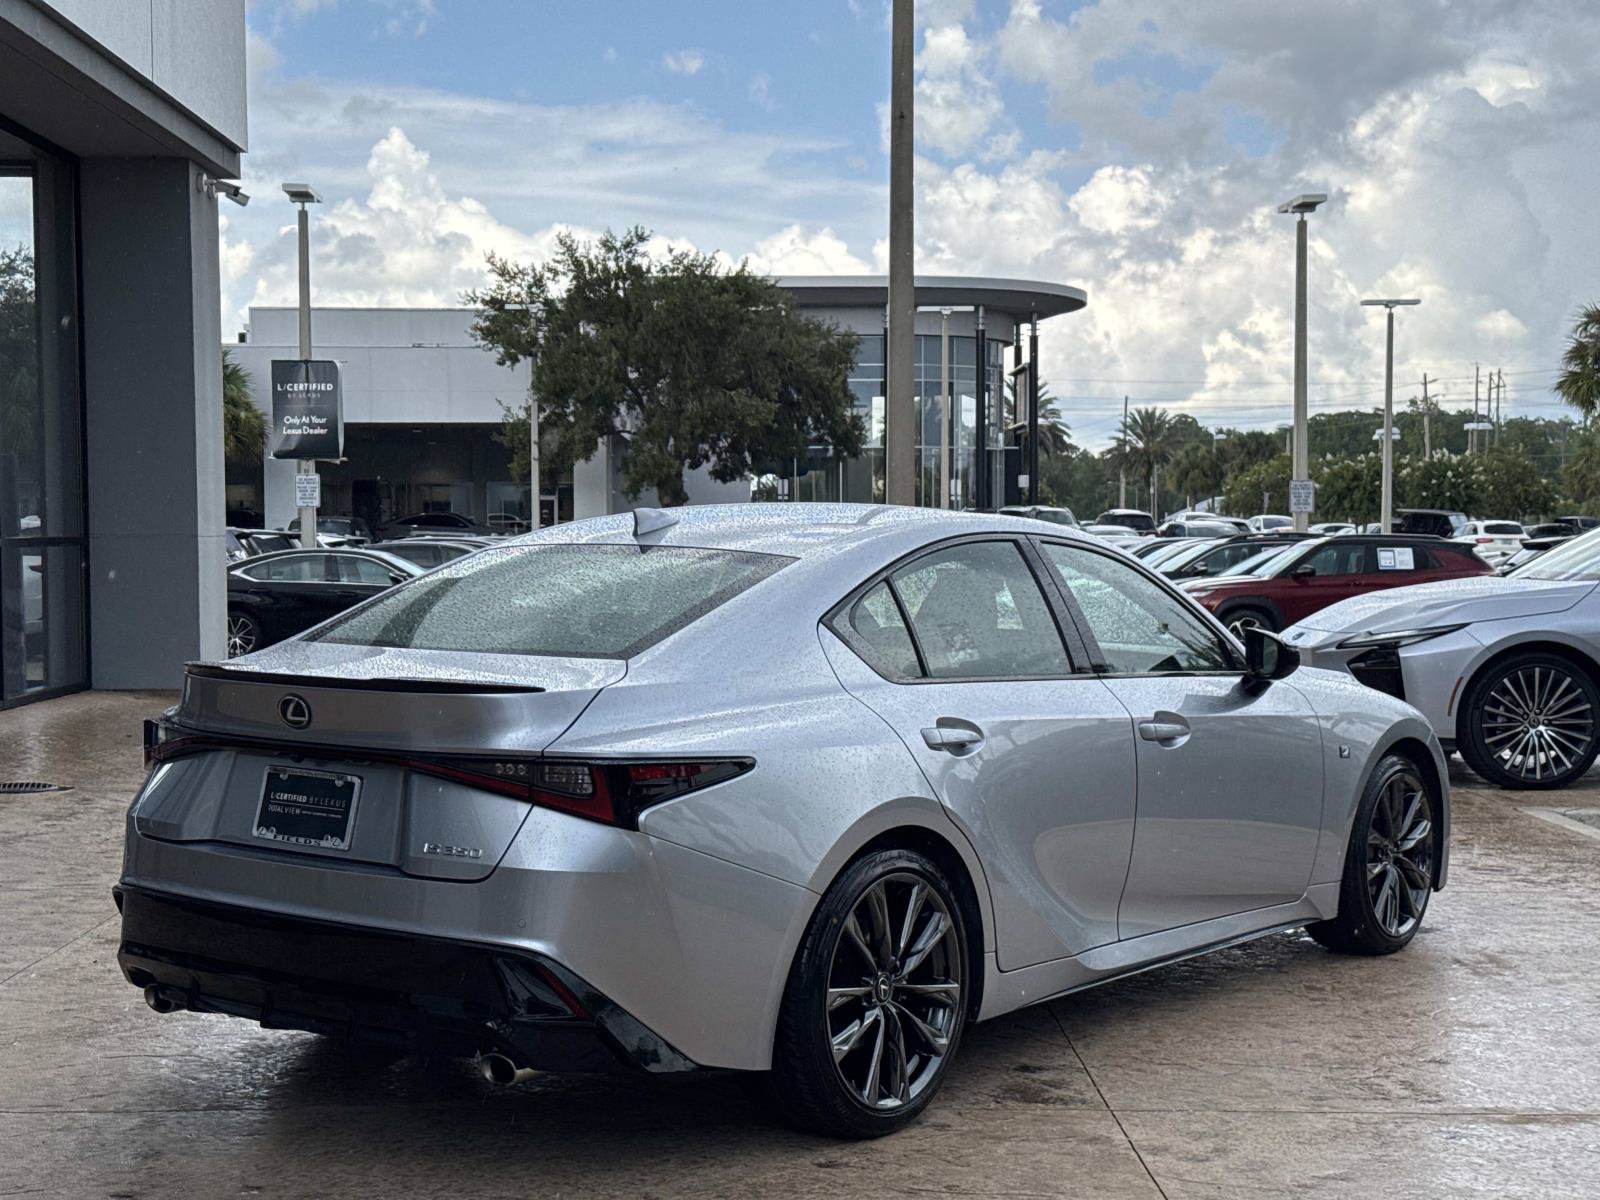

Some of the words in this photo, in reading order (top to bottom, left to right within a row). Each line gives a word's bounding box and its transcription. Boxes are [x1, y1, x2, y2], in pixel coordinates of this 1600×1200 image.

[283, 415, 301, 425] Only
[301, 415, 310, 424] At
[310, 415, 327, 424] Your
[302, 426, 328, 435] Dealer
[284, 806, 301, 815] VIEW
[273, 833, 321, 846] FIELDS
[443, 846, 482, 859] 350
